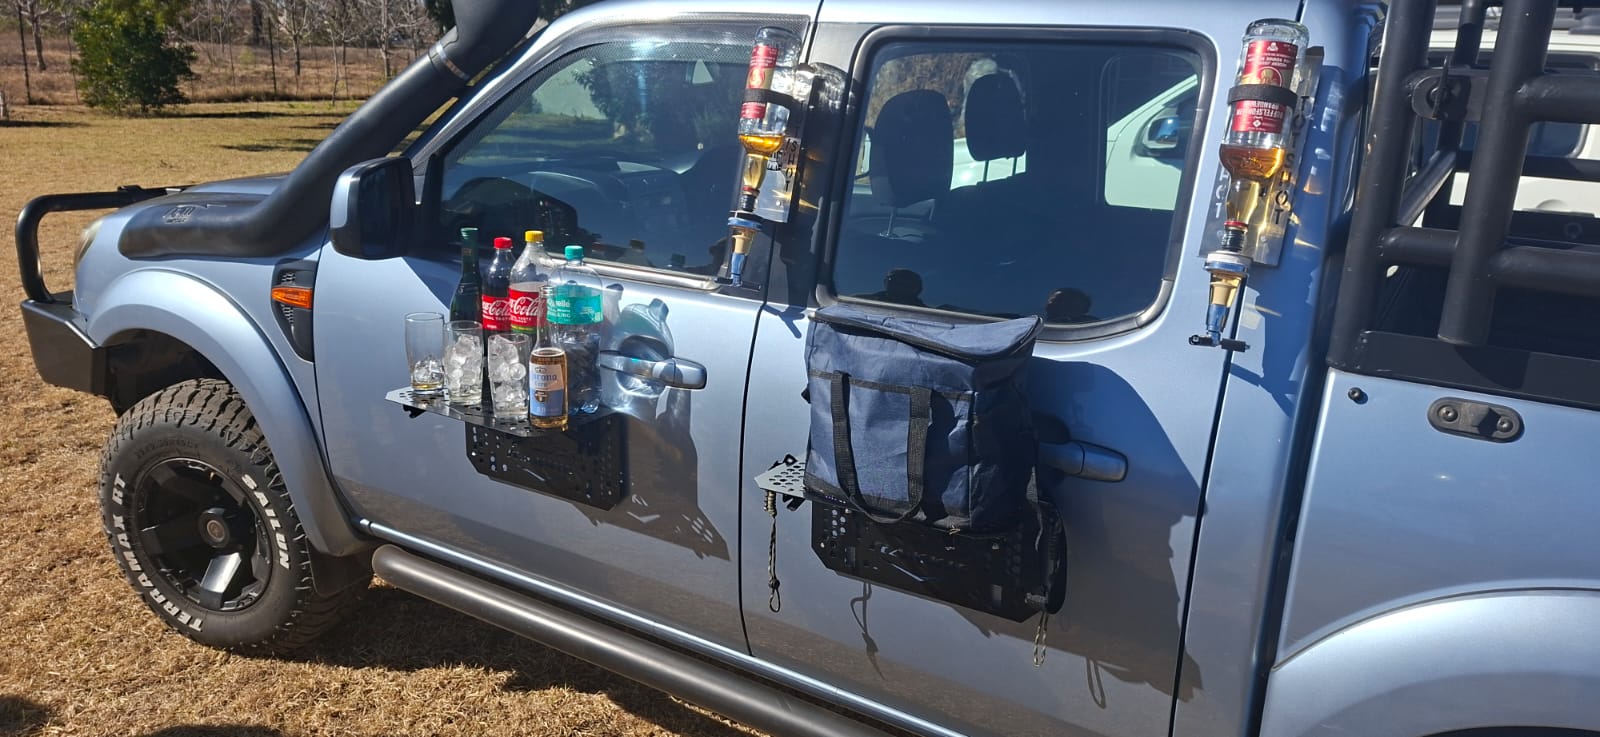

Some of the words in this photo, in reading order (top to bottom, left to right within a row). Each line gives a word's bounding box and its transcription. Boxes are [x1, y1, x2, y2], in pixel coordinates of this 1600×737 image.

[111, 472, 127, 506] RT
[241, 473, 291, 570] SAILUN
[112, 514, 203, 632] TERRAMAX
